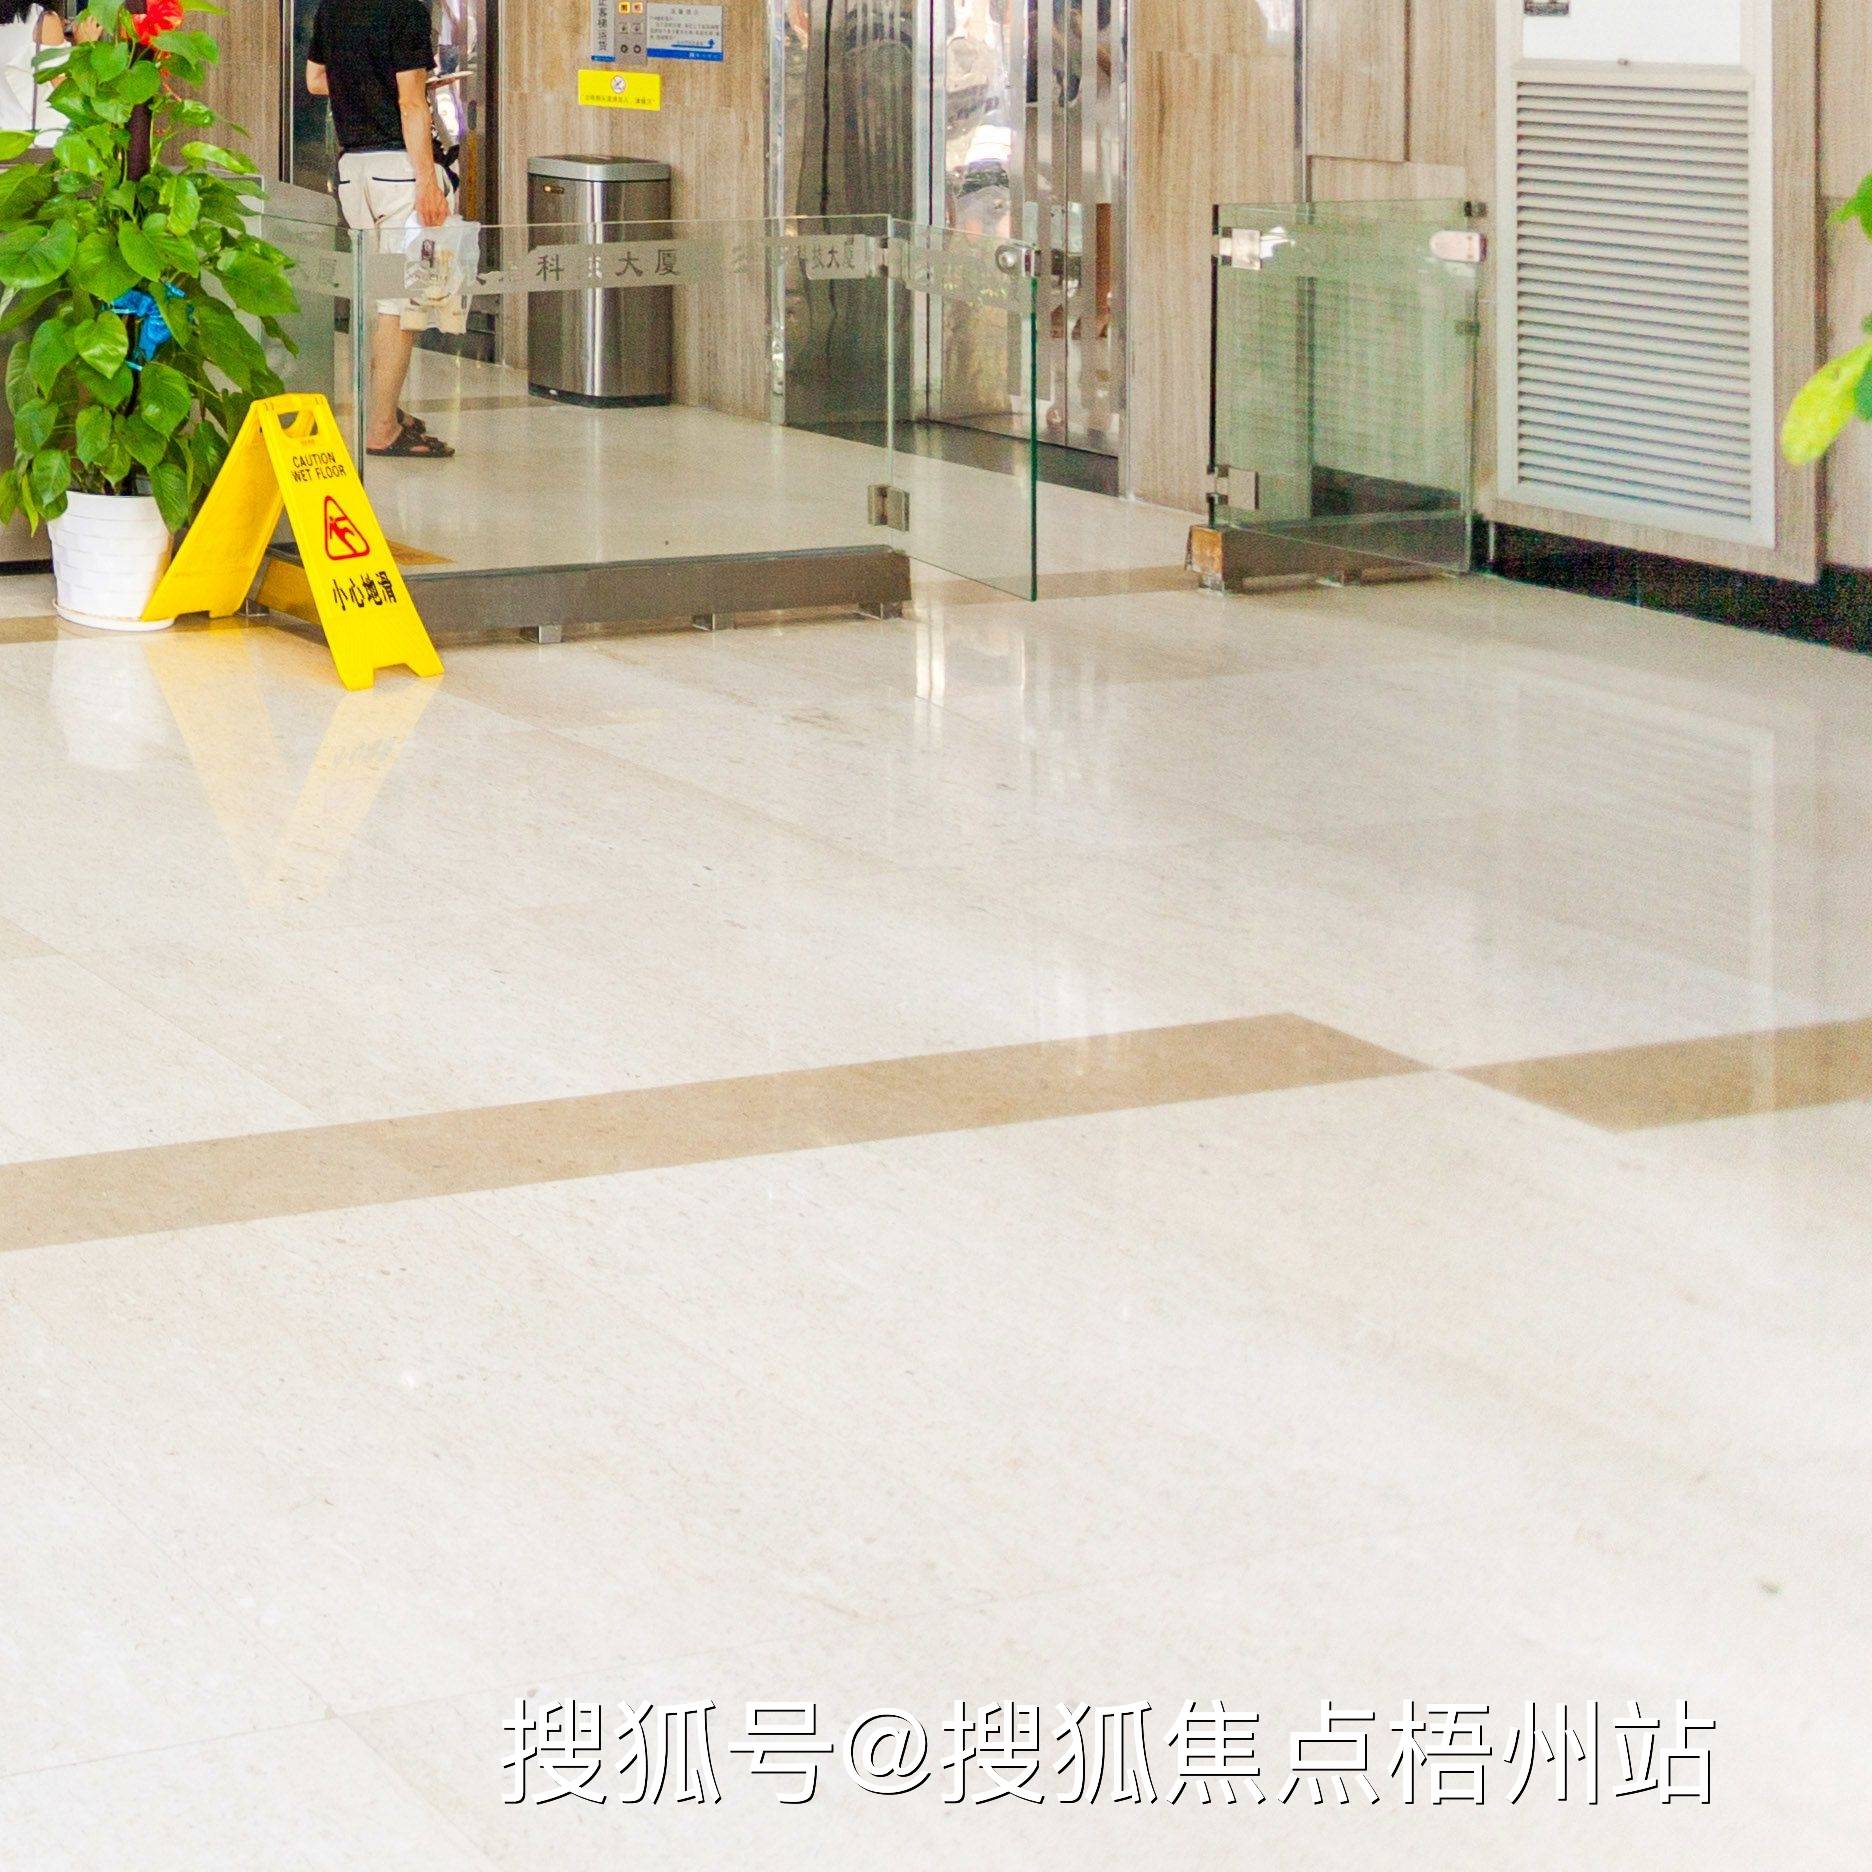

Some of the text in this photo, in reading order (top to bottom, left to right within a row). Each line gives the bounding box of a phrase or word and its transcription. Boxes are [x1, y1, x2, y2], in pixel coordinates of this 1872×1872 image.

[292, 452, 337, 469] CAUTION
[291, 464, 347, 482] WET FLOOR
[332, 570, 397, 612] 小心地滑
